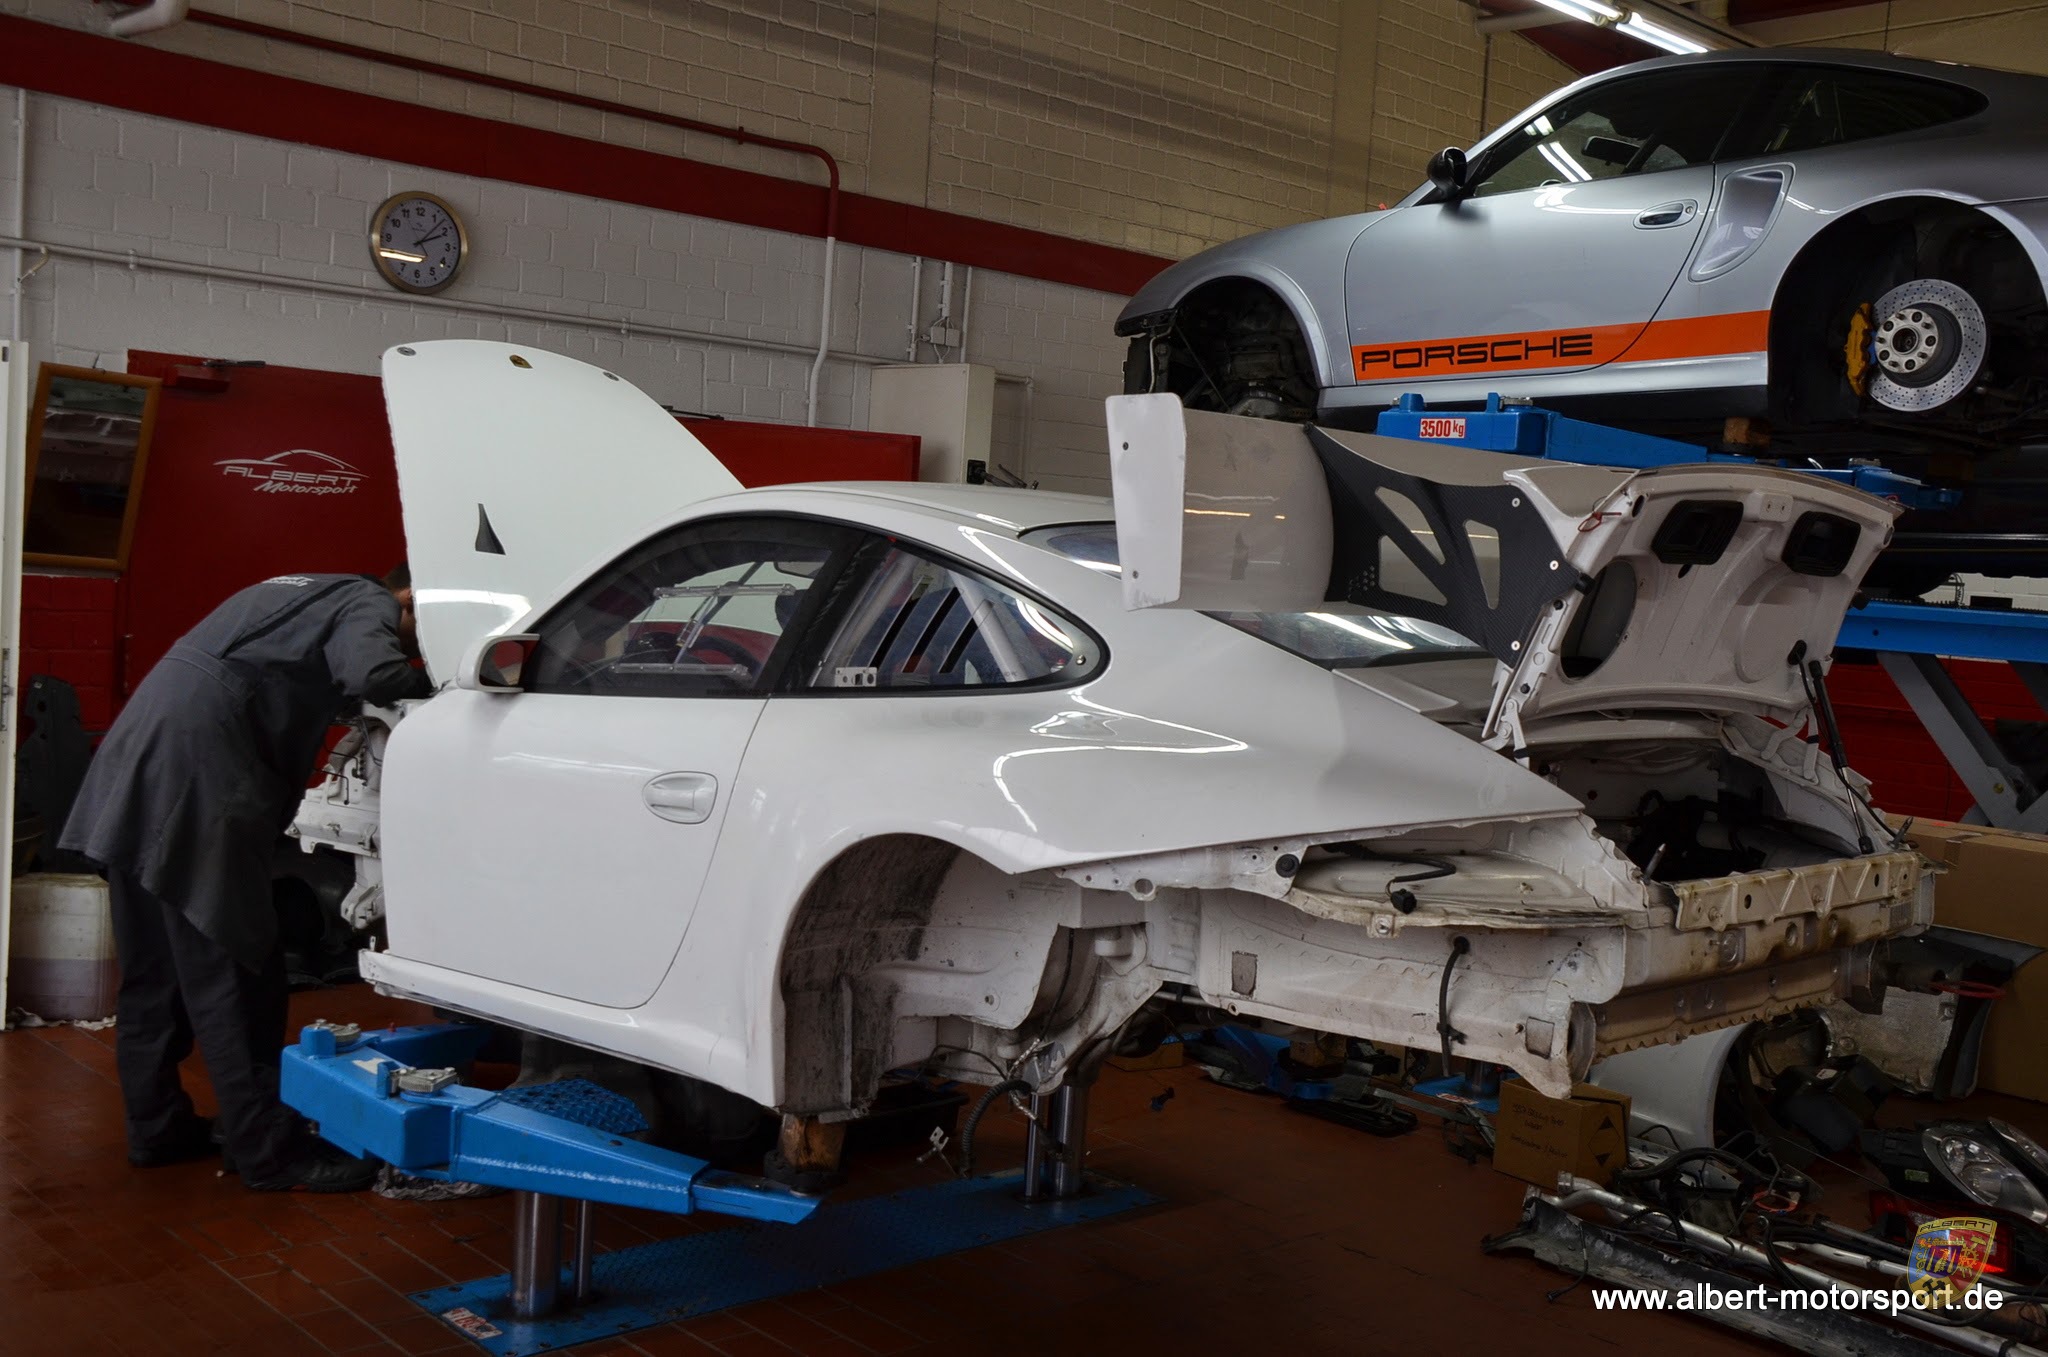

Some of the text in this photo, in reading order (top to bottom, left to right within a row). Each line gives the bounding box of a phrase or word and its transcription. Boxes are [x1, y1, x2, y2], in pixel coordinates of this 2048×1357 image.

[402, 209, 410, 218] 11
[416, 207, 425, 216] 12
[432, 214, 437, 222] 1
[391, 219, 401, 228] 10
[442, 227, 448, 236] 2
[385, 233, 392, 242] 9
[445, 243, 451, 252] 3
[400, 263, 406, 271] 7
[429, 267, 435, 275] 5
[414, 269, 420, 278] 6
[1362, 334, 1593, 371] PORSCHE
[1421, 420, 1465, 437] 3500 kg
[223, 466, 361, 486] ALBERT
[254, 481, 358, 495] Motorsport
